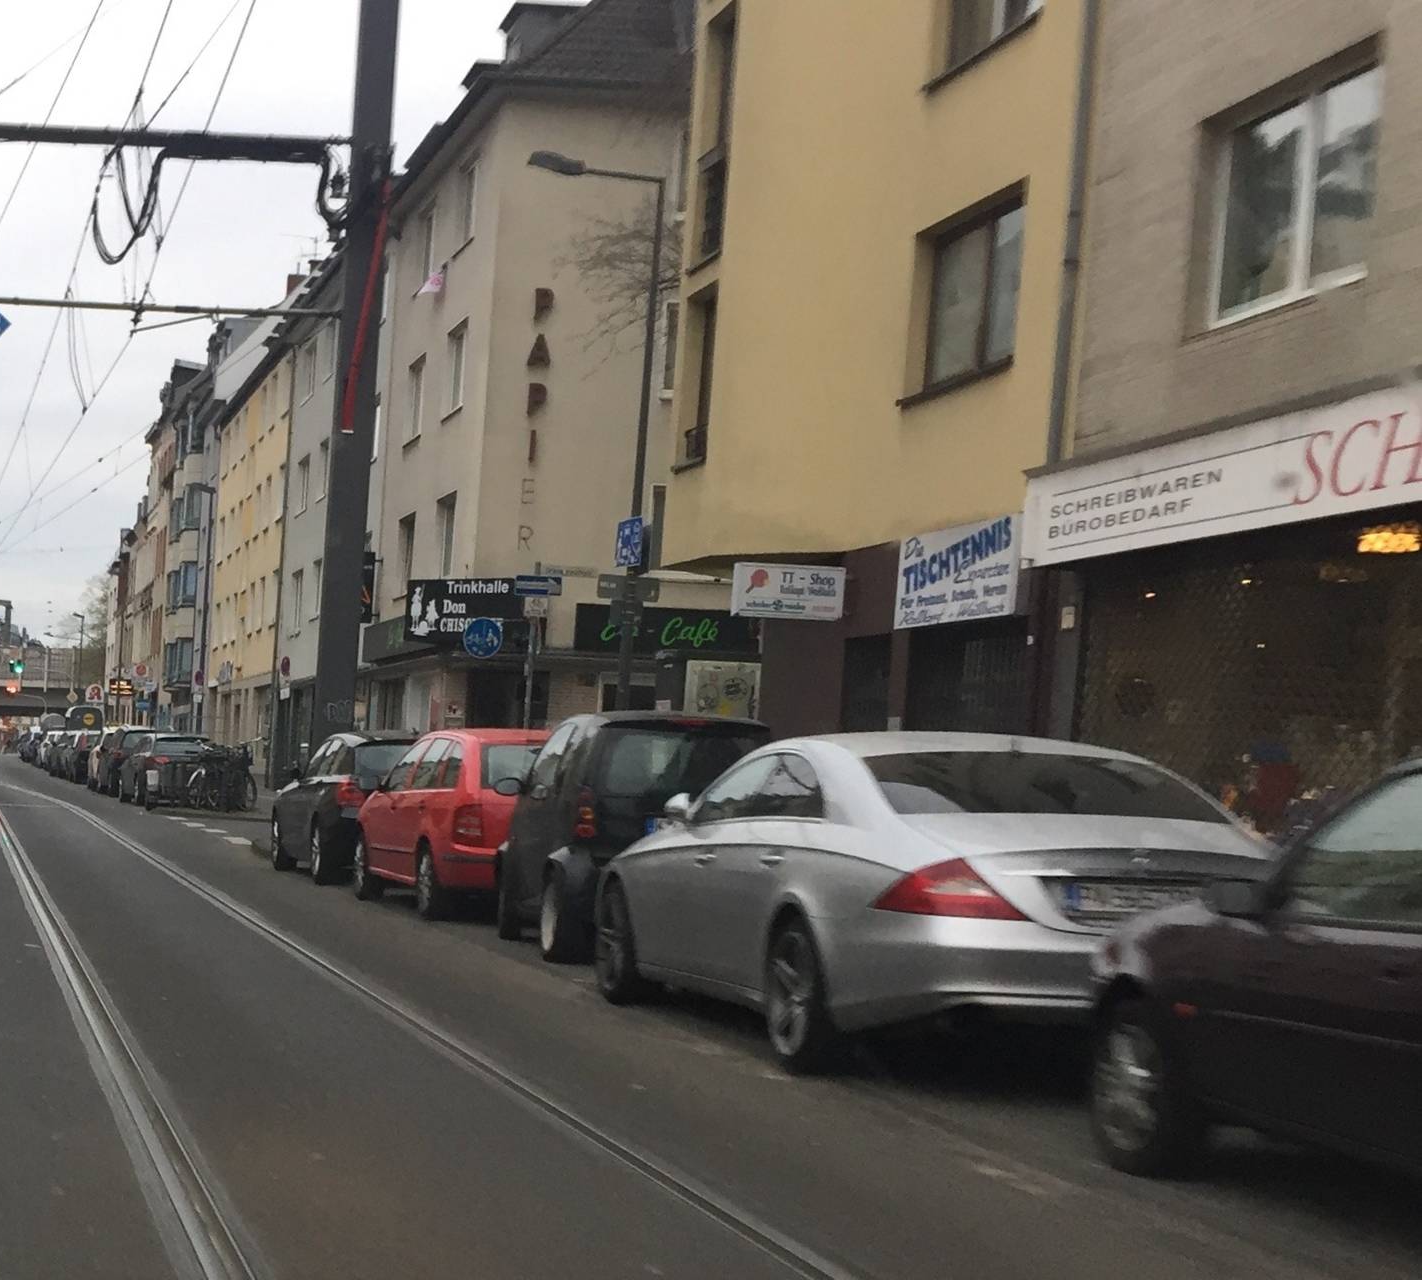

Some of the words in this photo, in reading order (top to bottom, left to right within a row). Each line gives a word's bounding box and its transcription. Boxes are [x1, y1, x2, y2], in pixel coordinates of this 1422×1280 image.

[518, 288, 555, 551] PAPIER
[1050, 468, 1225, 519] SCHREIBWAREN
[1048, 497, 1194, 540] BÜROBEDARF
[903, 516, 1012, 595] TISCHTENNIS
[446, 580, 510, 595] Trinkhalle
[781, 571, 795, 584] TT
[810, 573, 835, 589] Shop
[442, 599, 466, 614] Don
[660, 614, 719, 647] Café
